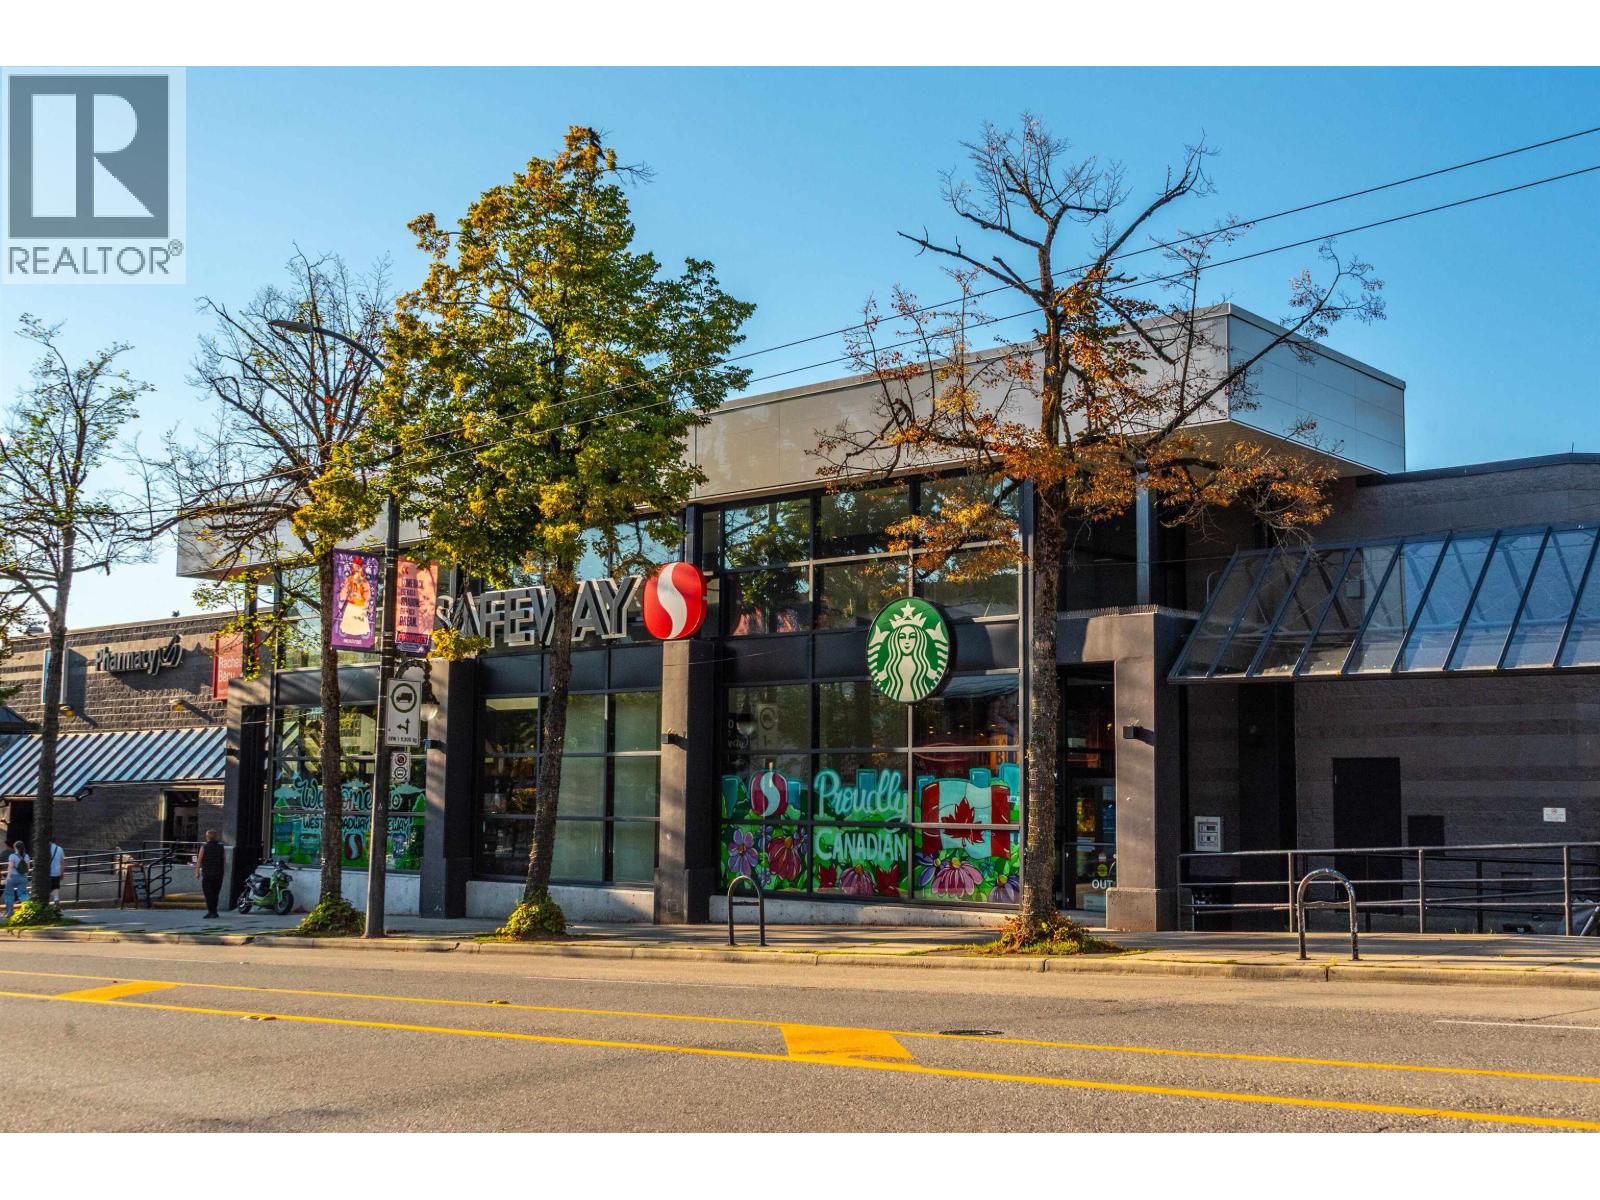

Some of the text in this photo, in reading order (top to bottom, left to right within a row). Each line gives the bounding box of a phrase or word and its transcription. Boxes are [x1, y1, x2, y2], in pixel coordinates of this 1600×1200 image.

[95, 645, 160, 676] Pharmacy
[813, 768, 908, 832] Proudly
[814, 829, 907, 862] CANADIAN
[1091, 879, 1113, 889] OUT
